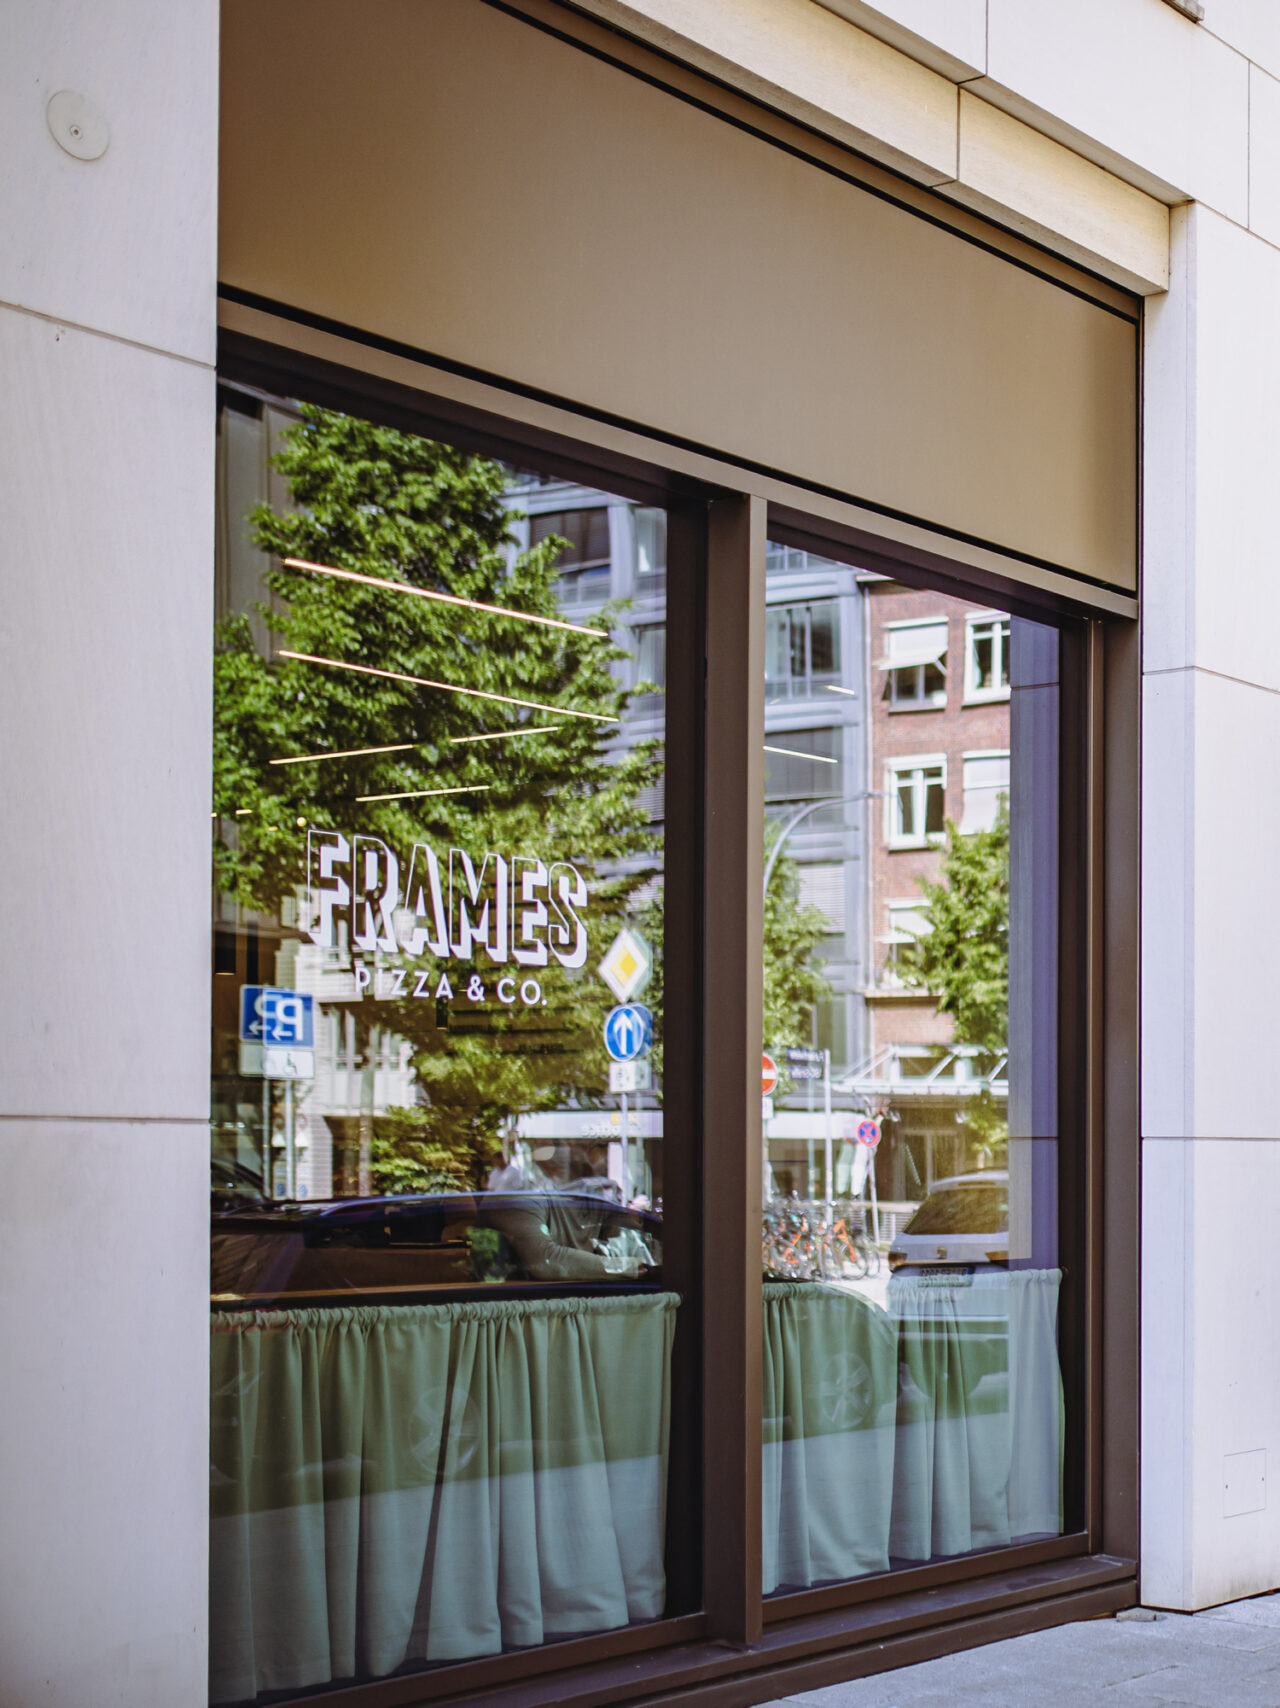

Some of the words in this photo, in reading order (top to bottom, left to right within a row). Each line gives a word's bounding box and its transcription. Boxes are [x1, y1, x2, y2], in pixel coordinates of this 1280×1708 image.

[307, 829, 588, 968] FRAMES
[355, 967, 454, 1000] PIZZA
[467, 975, 485, 1002] &
[497, 977, 548, 1007] CO.
